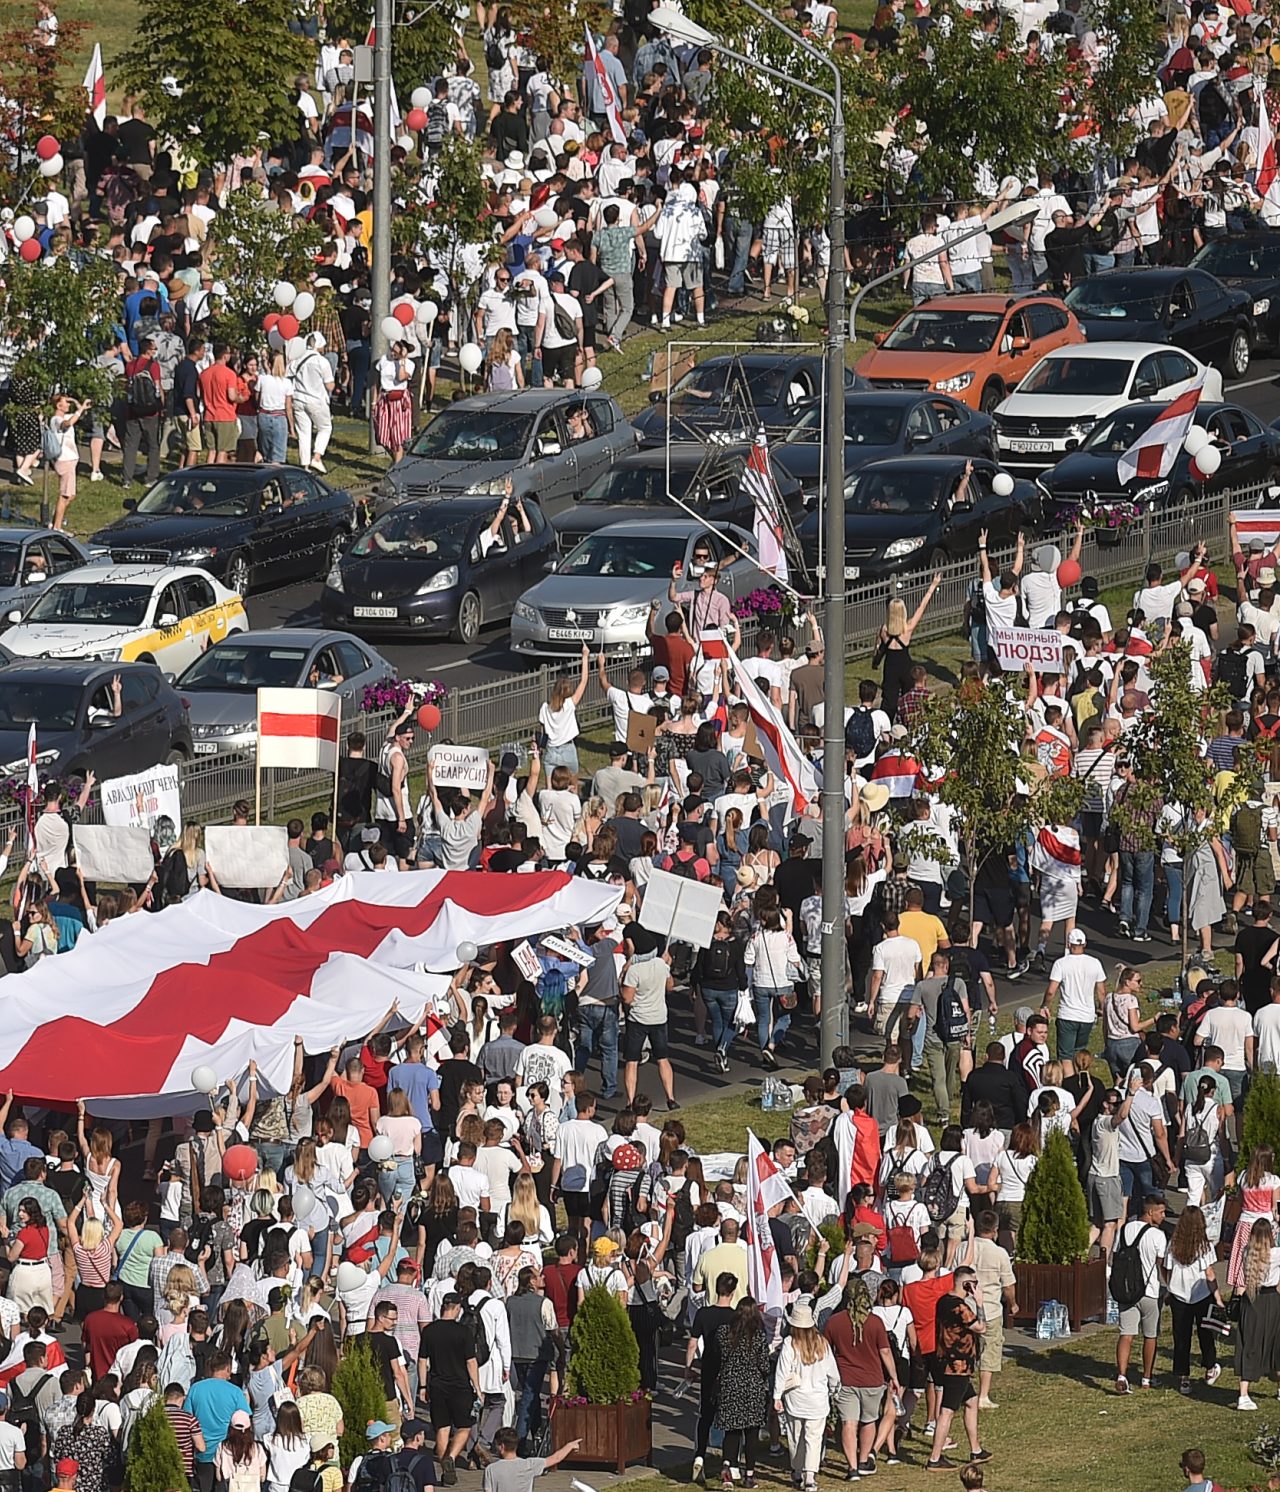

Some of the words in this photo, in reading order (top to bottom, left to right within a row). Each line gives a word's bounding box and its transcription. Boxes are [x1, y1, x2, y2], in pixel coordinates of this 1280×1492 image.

[996, 630, 1014, 641] МЫ
[1016, 632, 1058, 644] МІРНЫЯ
[996, 642, 1060, 663] ЛЮДЗІ
[434, 752, 479, 763] ПОШЛИ
